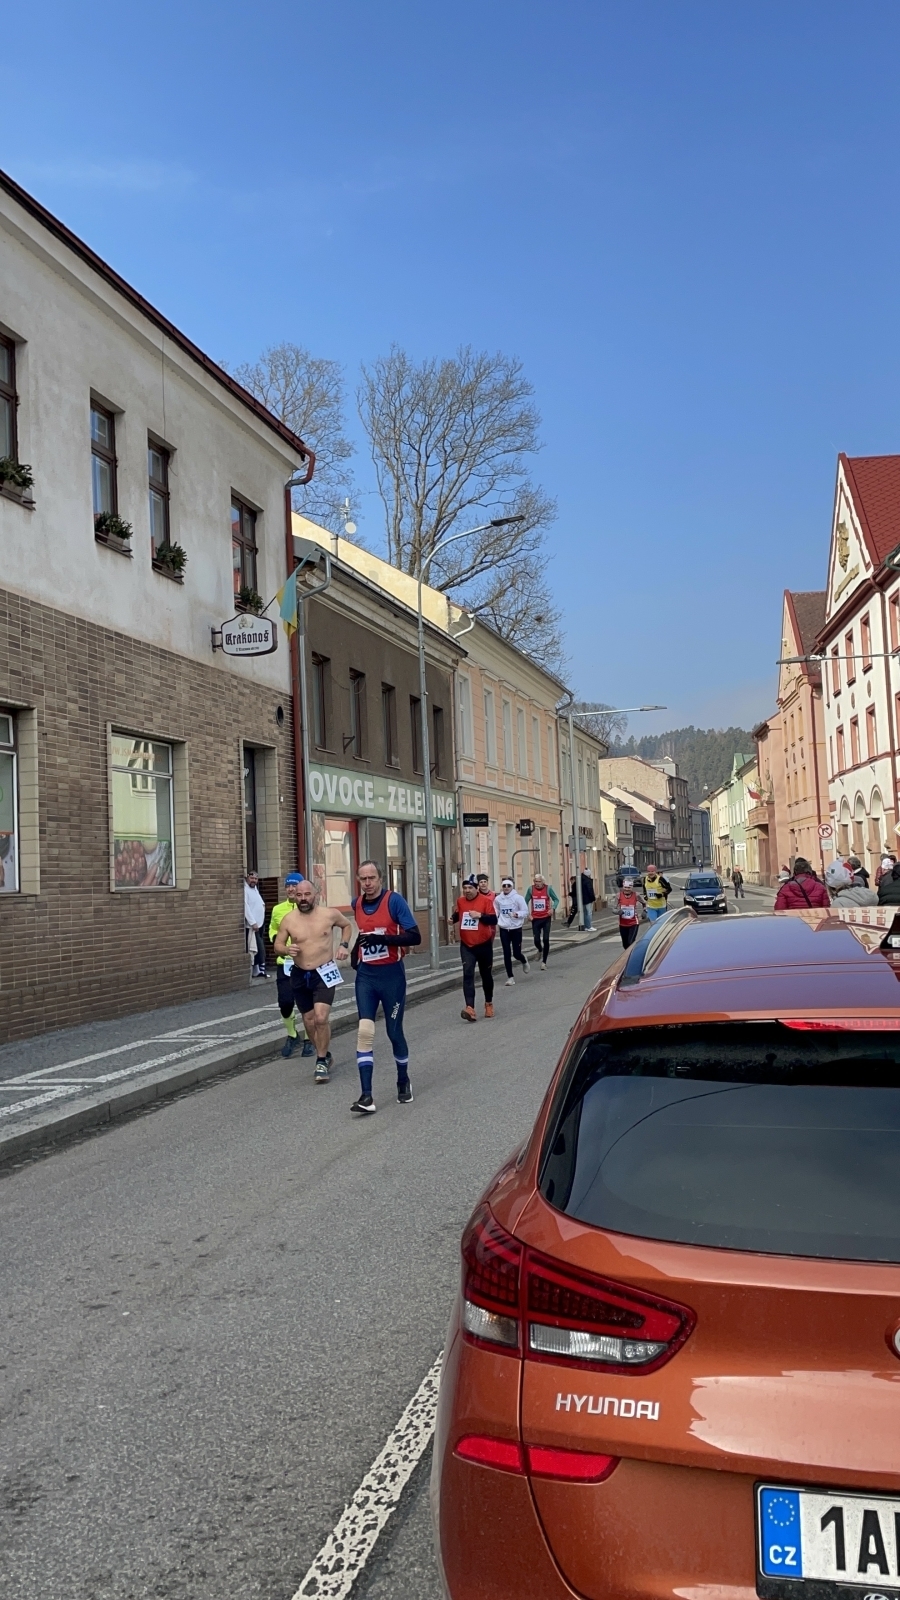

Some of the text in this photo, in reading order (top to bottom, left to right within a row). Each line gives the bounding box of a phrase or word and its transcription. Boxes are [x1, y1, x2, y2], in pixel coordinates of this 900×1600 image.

[225, 630, 270, 645] Krakonoš
[309, 771, 374, 809] OVOCE
[463, 918, 476, 926] 212
[363, 944, 386, 956] 202
[323, 969, 340, 982] 335
[555, 1393, 660, 1420] HYUNDAI
[820, 1506, 900, 1577] 1A
[769, 1544, 797, 1566] CZ
